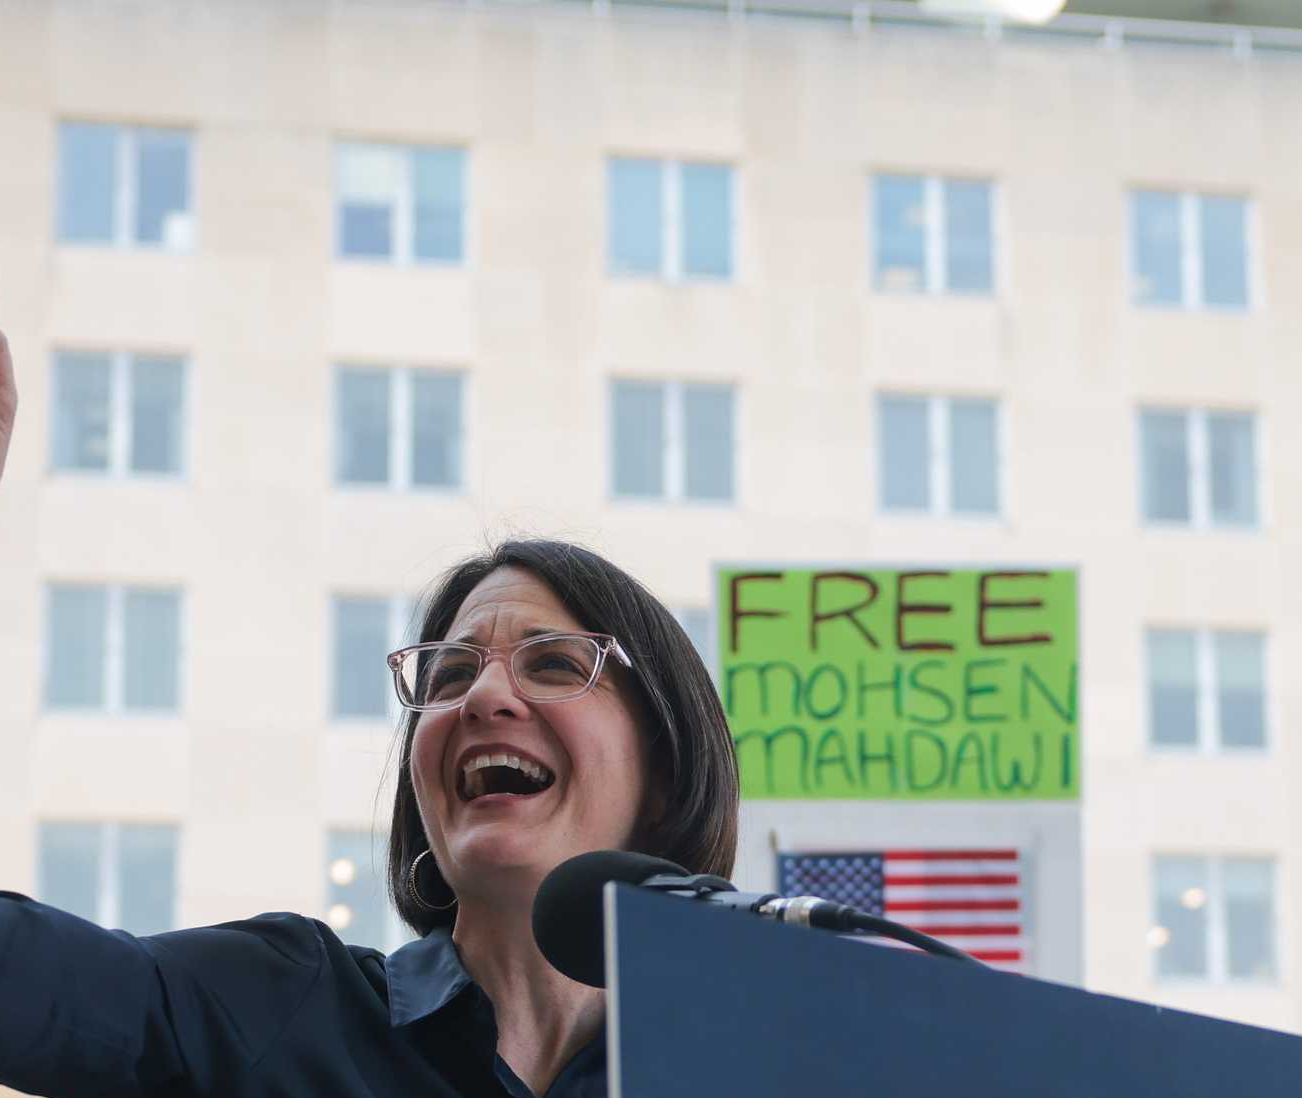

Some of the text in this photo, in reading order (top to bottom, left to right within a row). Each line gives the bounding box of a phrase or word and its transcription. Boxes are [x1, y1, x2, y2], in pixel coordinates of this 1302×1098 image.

[728, 570, 1054, 654] FREE
[724, 658, 1079, 727] MOHSEN
[735, 726, 1071, 793] MAHDAWI
